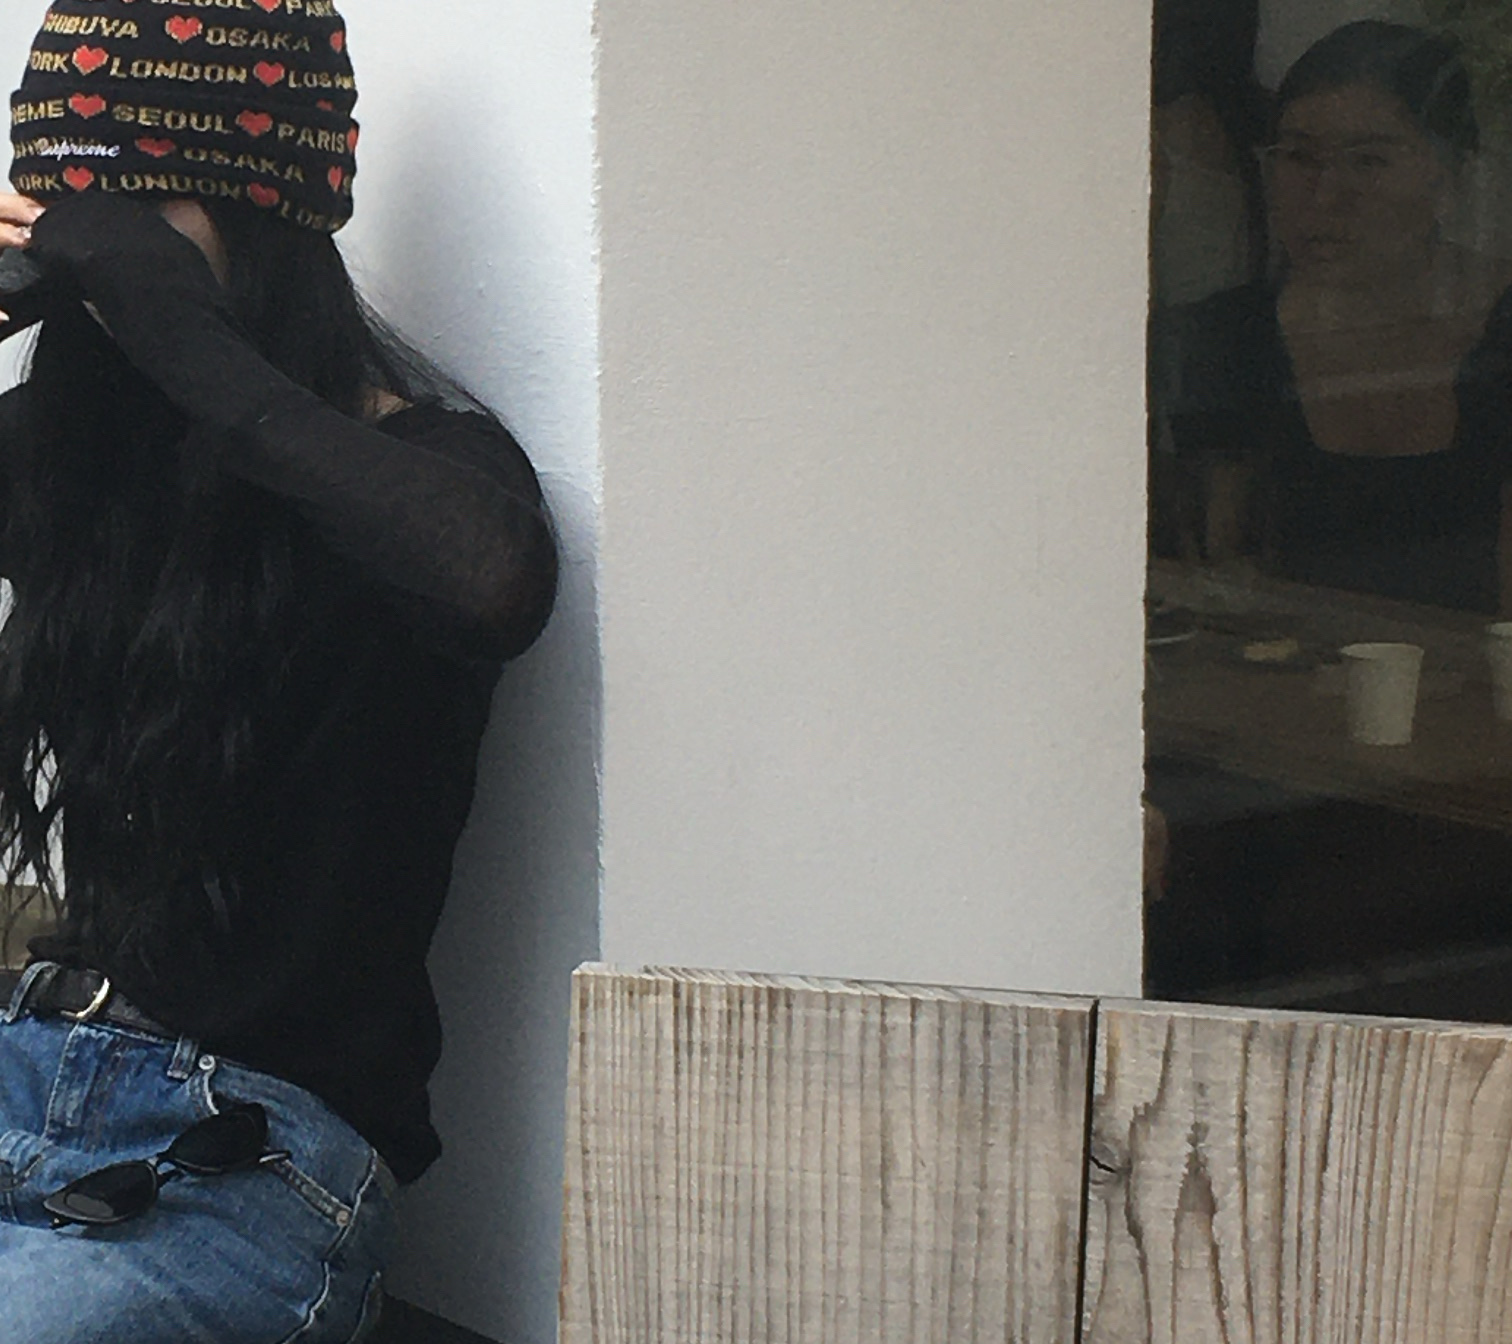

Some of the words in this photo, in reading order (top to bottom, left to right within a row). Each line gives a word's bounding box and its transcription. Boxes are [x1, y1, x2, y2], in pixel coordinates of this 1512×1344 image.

[205, 20, 311, 53] OSAKA
[109, 56, 248, 84] LONDON
[112, 103, 236, 135] SEOUL
[276, 121, 346, 155] PARIS
[39, 138, 121, 162] Supreme
[183, 146, 305, 184] OSAKA
